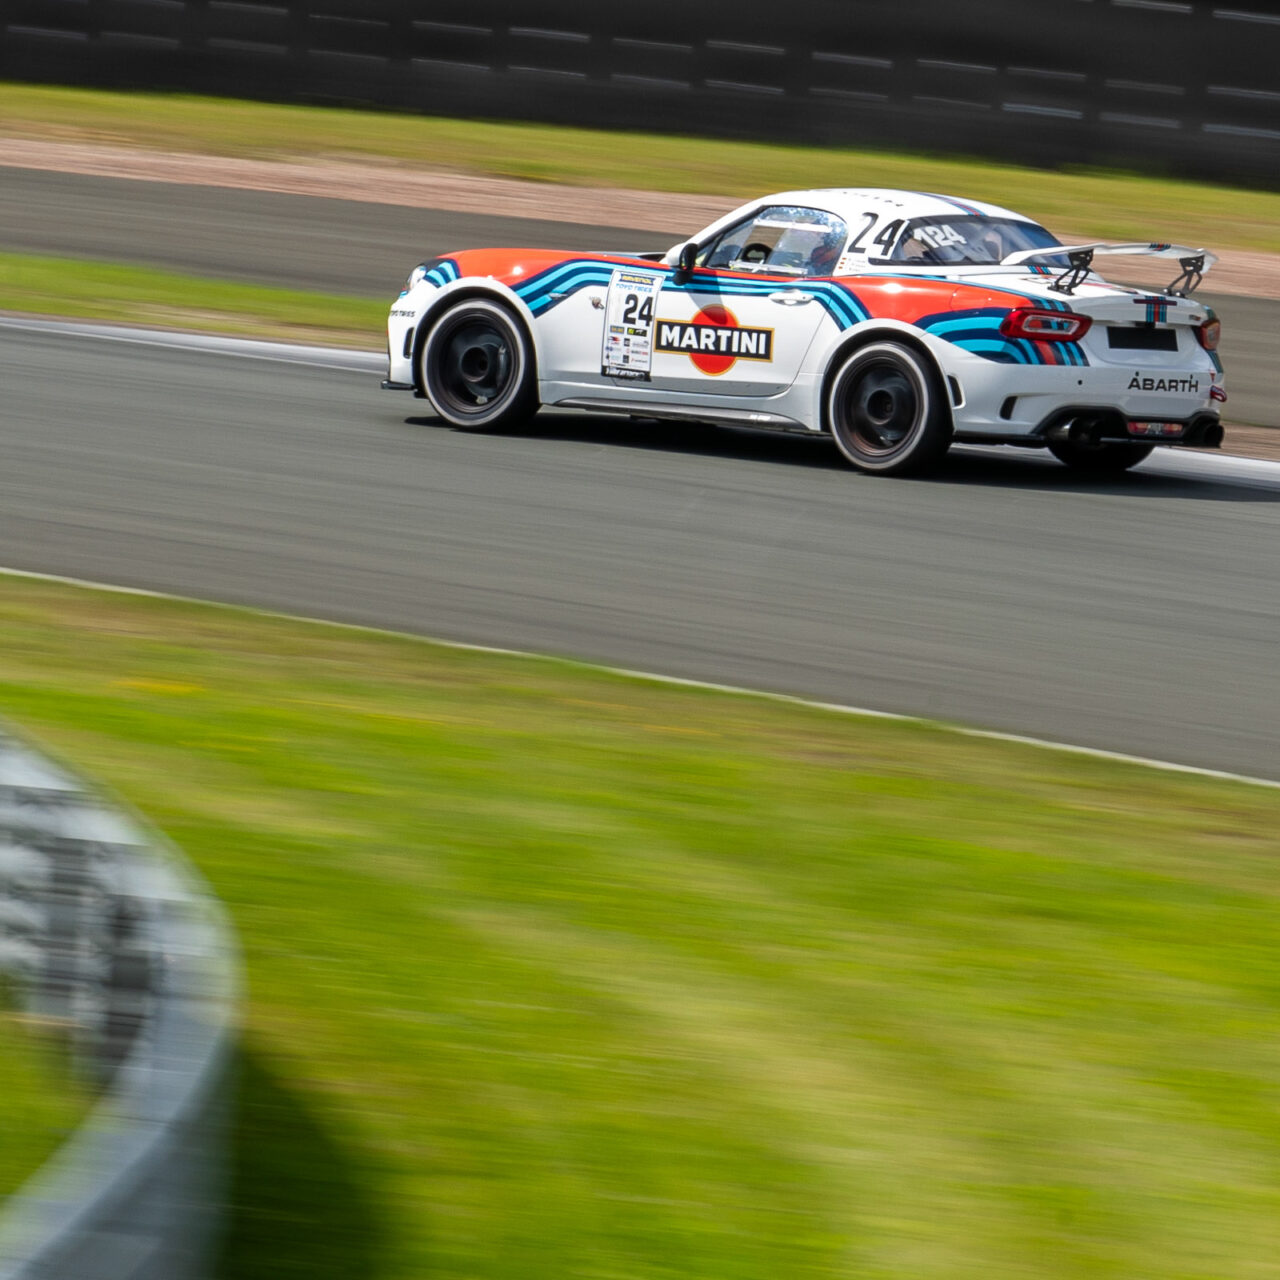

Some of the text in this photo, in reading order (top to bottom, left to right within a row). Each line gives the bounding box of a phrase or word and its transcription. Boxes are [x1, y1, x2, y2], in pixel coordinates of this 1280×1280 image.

[847, 212, 905, 256] 24
[913, 224, 967, 248] 124
[623, 293, 653, 327] 24
[660, 324, 766, 355] MARTINI
[1128, 372, 1198, 392] ABARTH
